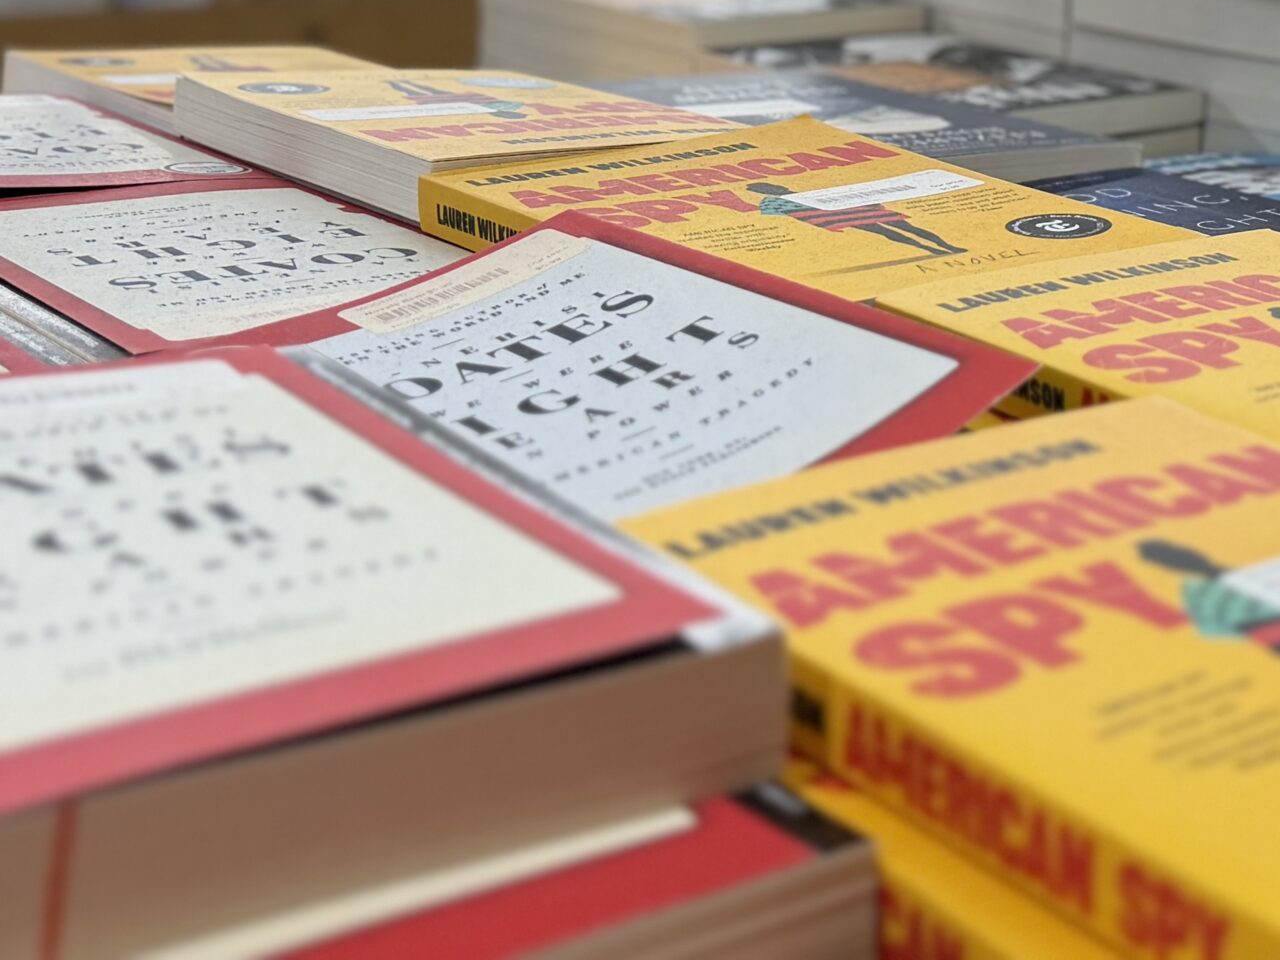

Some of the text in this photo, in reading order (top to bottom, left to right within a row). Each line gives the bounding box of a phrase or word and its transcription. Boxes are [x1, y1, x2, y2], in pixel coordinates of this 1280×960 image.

[464, 141, 760, 189] LAUREN WILKINSON
[508, 139, 900, 209] AMERICAN
[436, 202, 478, 237] LAUREN
[562, 188, 762, 229] SPY
[71, 227, 367, 268] EIGHT
[108, 246, 420, 295] COATES
[943, 248, 1042, 270] NOVEL
[431, 310, 504, 338] WORLD
[513, 288, 550, 308] AND
[558, 271, 586, 287] ME
[452, 293, 533, 326] AUTHOR
[936, 252, 1240, 314] LAUREN WILKINSON
[391, 290, 606, 377] -NEHISI
[522, 339, 635, 391] WERE
[552, 430, 684, 484] MERICAN
[698, 356, 818, 427] TRAGEDY
[586, 368, 734, 441] POWER
[661, 490, 860, 562] LAUREN
[848, 438, 1107, 508] WILKINSON
[852, 559, 1191, 699] SPY
[845, 700, 1100, 920] AMERICAN
[1114, 856, 1234, 960] SPY
